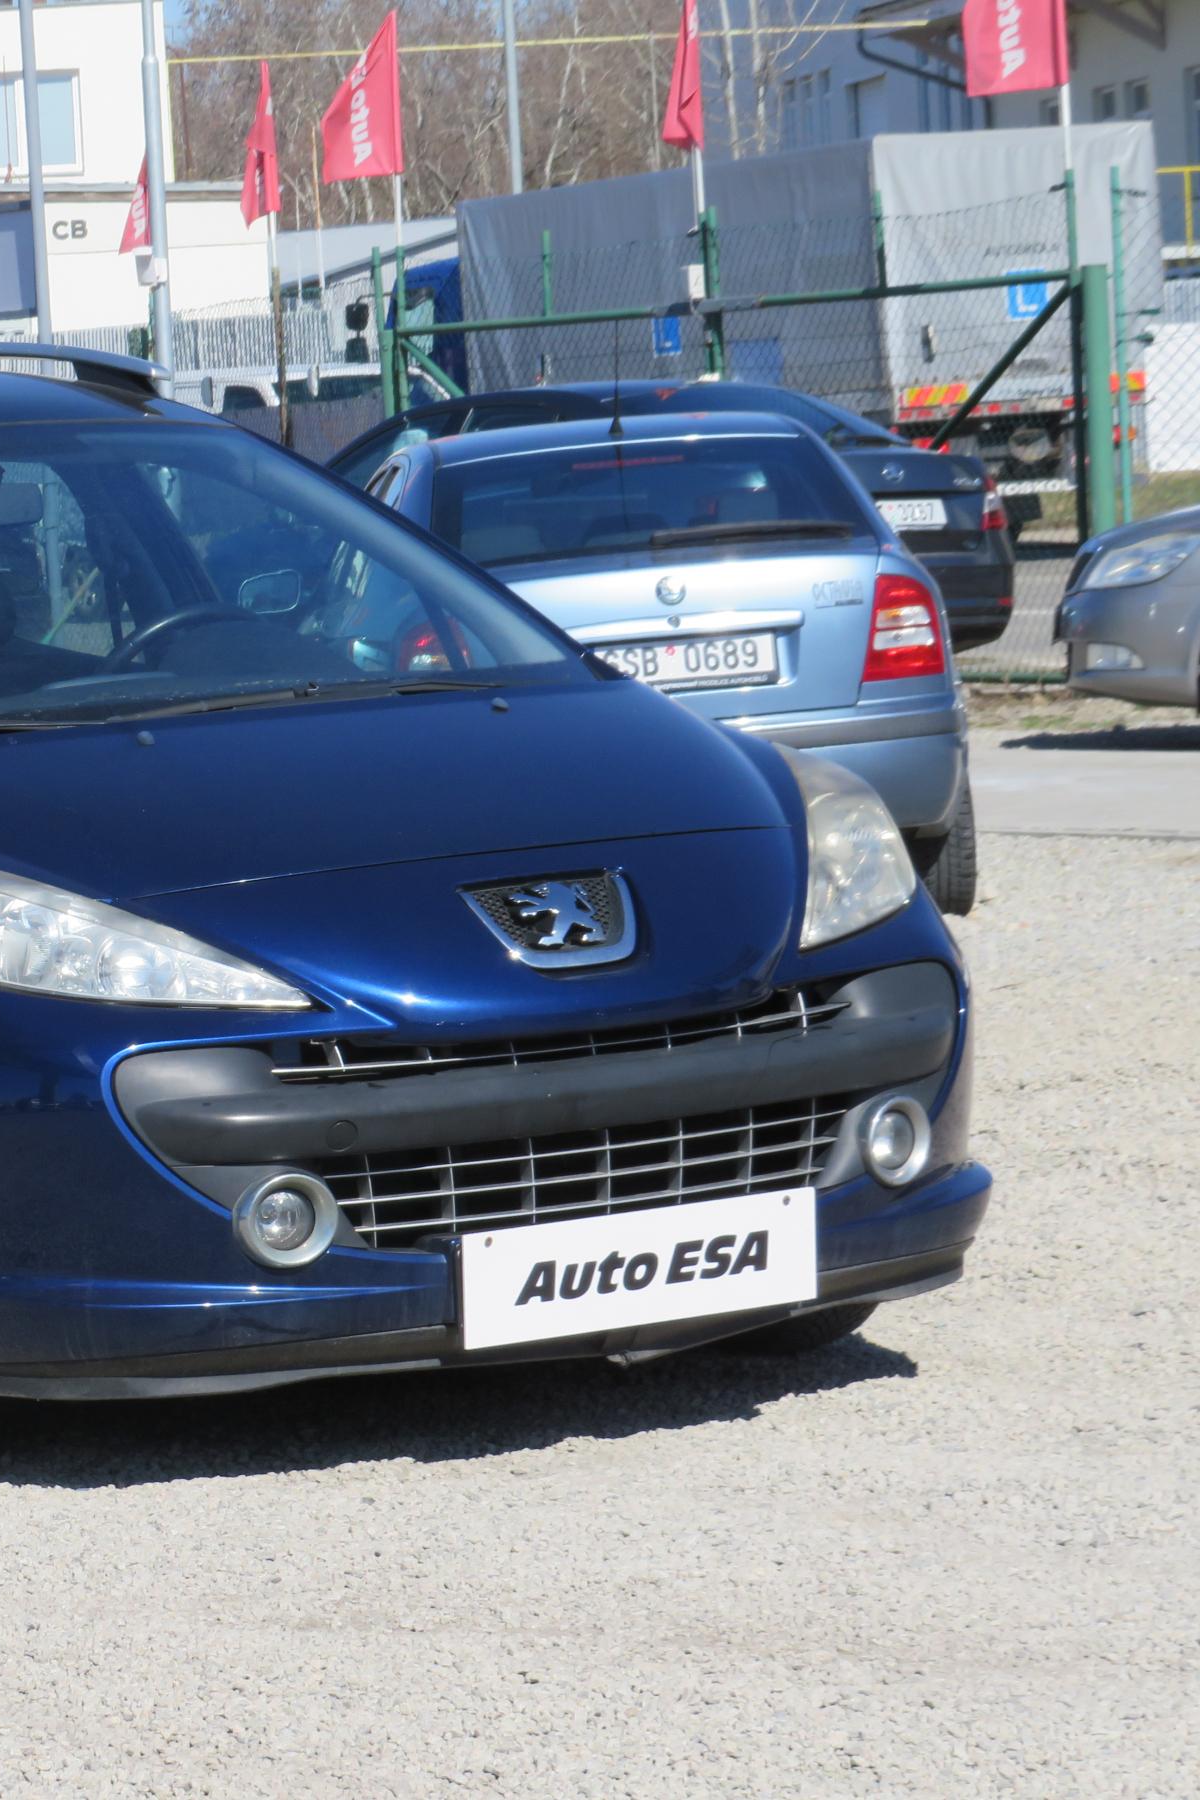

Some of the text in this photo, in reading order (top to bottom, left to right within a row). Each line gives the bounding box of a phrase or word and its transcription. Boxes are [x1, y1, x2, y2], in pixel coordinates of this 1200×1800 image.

[52, 219, 88, 240] CB
[683, 639, 759, 673] 0689
[514, 1230, 769, 1306] Auto ESA
